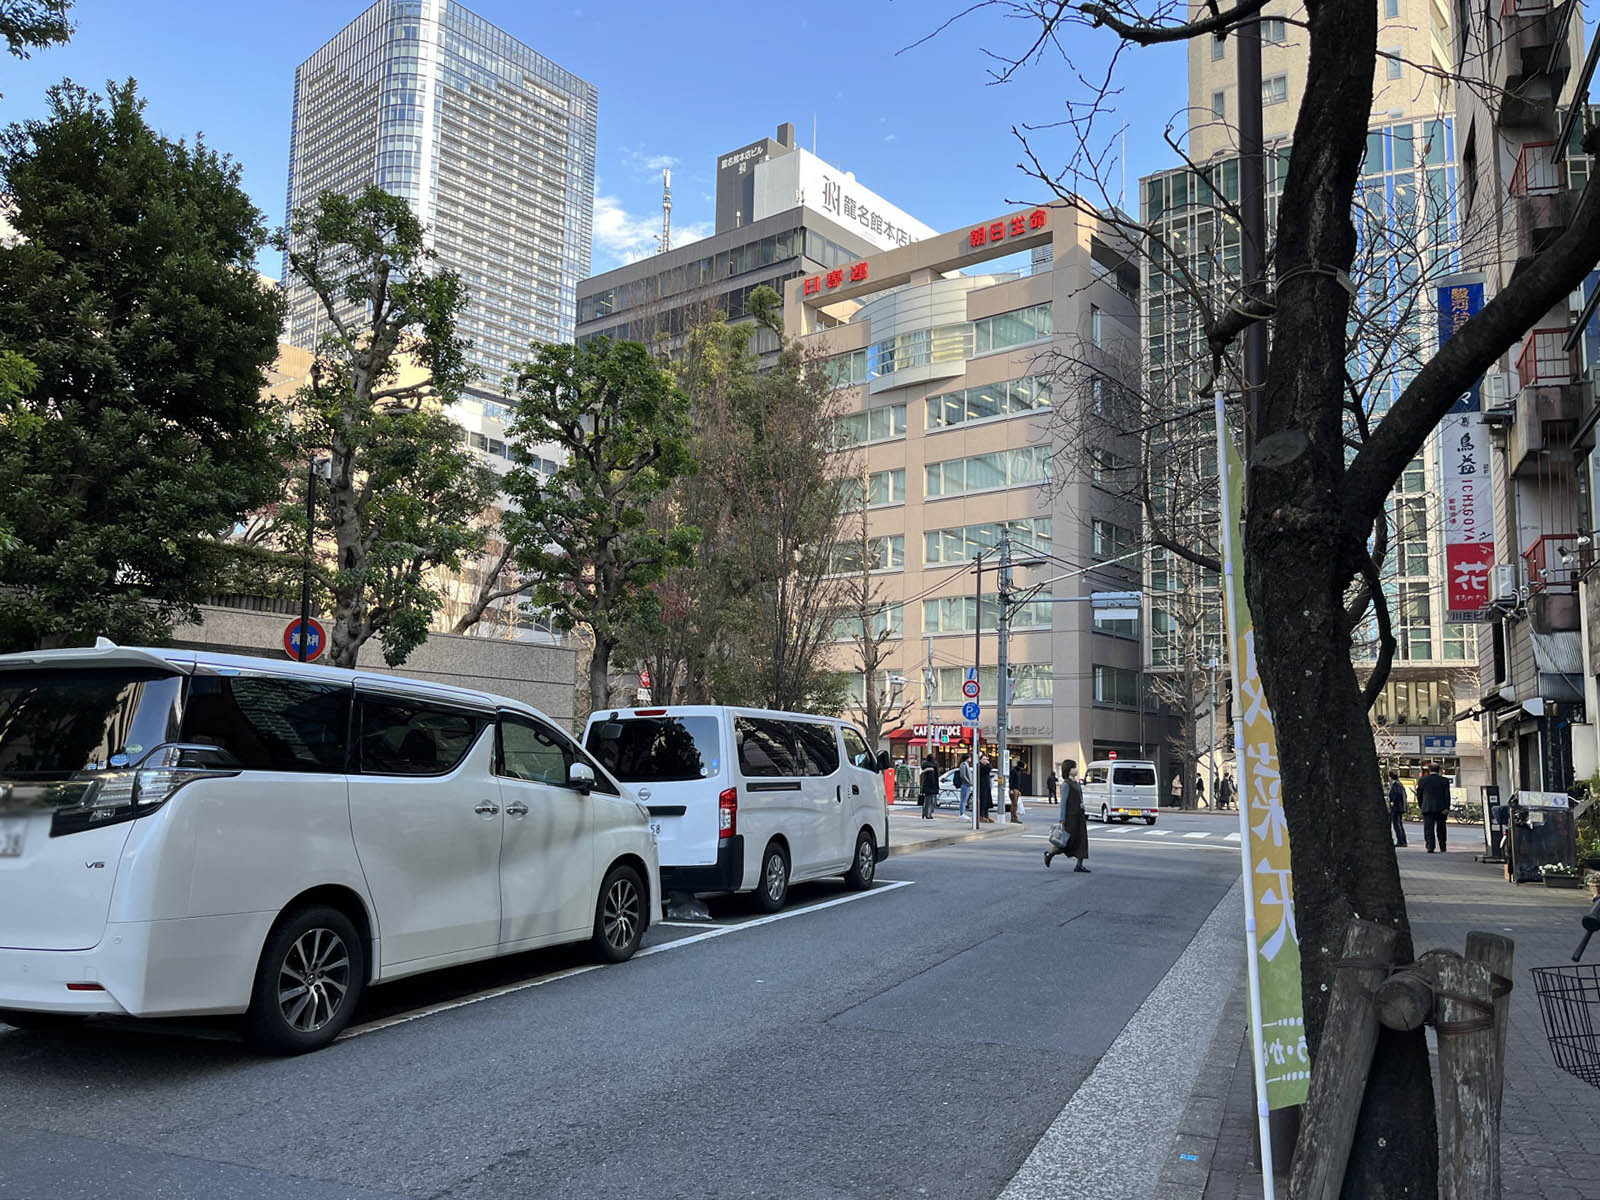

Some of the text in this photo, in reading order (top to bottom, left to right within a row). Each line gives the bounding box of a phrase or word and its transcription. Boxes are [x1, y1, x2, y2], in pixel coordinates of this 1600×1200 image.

[970, 209, 1047, 247] 朝日生命
[1461, 480, 1475, 541] ICHIGOYA
[1454, 560, 1488, 590] 花
[967, 685, 977, 694] 20
[85, 861, 105, 869] V6
